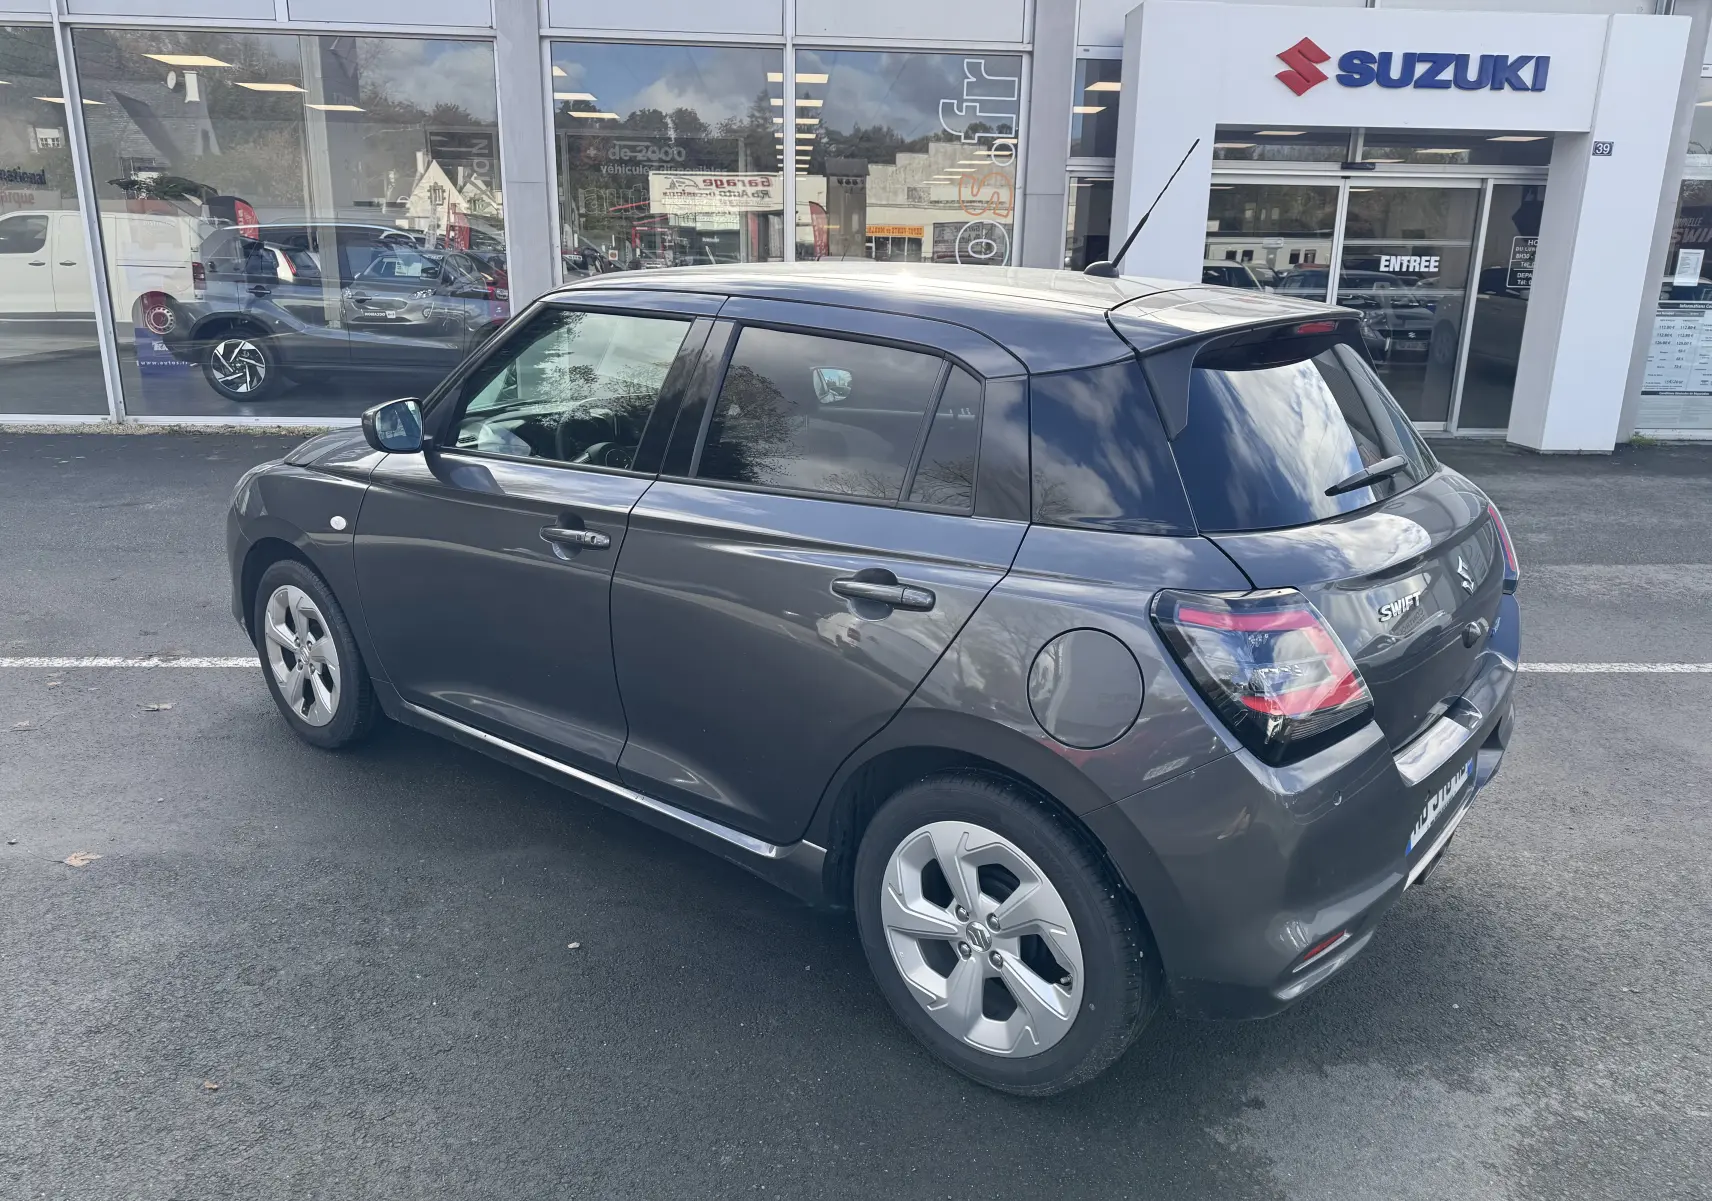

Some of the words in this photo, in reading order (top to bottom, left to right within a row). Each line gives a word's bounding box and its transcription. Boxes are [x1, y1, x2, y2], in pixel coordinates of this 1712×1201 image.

[1336, 50, 1551, 92] SUZUKI
[608, 146, 630, 160] de
[634, 146, 686, 161] 2000
[1595, 143, 1610, 154] 39
[600, 162, 655, 176] véhicules
[1379, 255, 1441, 272] ENTREE
[1378, 591, 1421, 623] SWIFT
